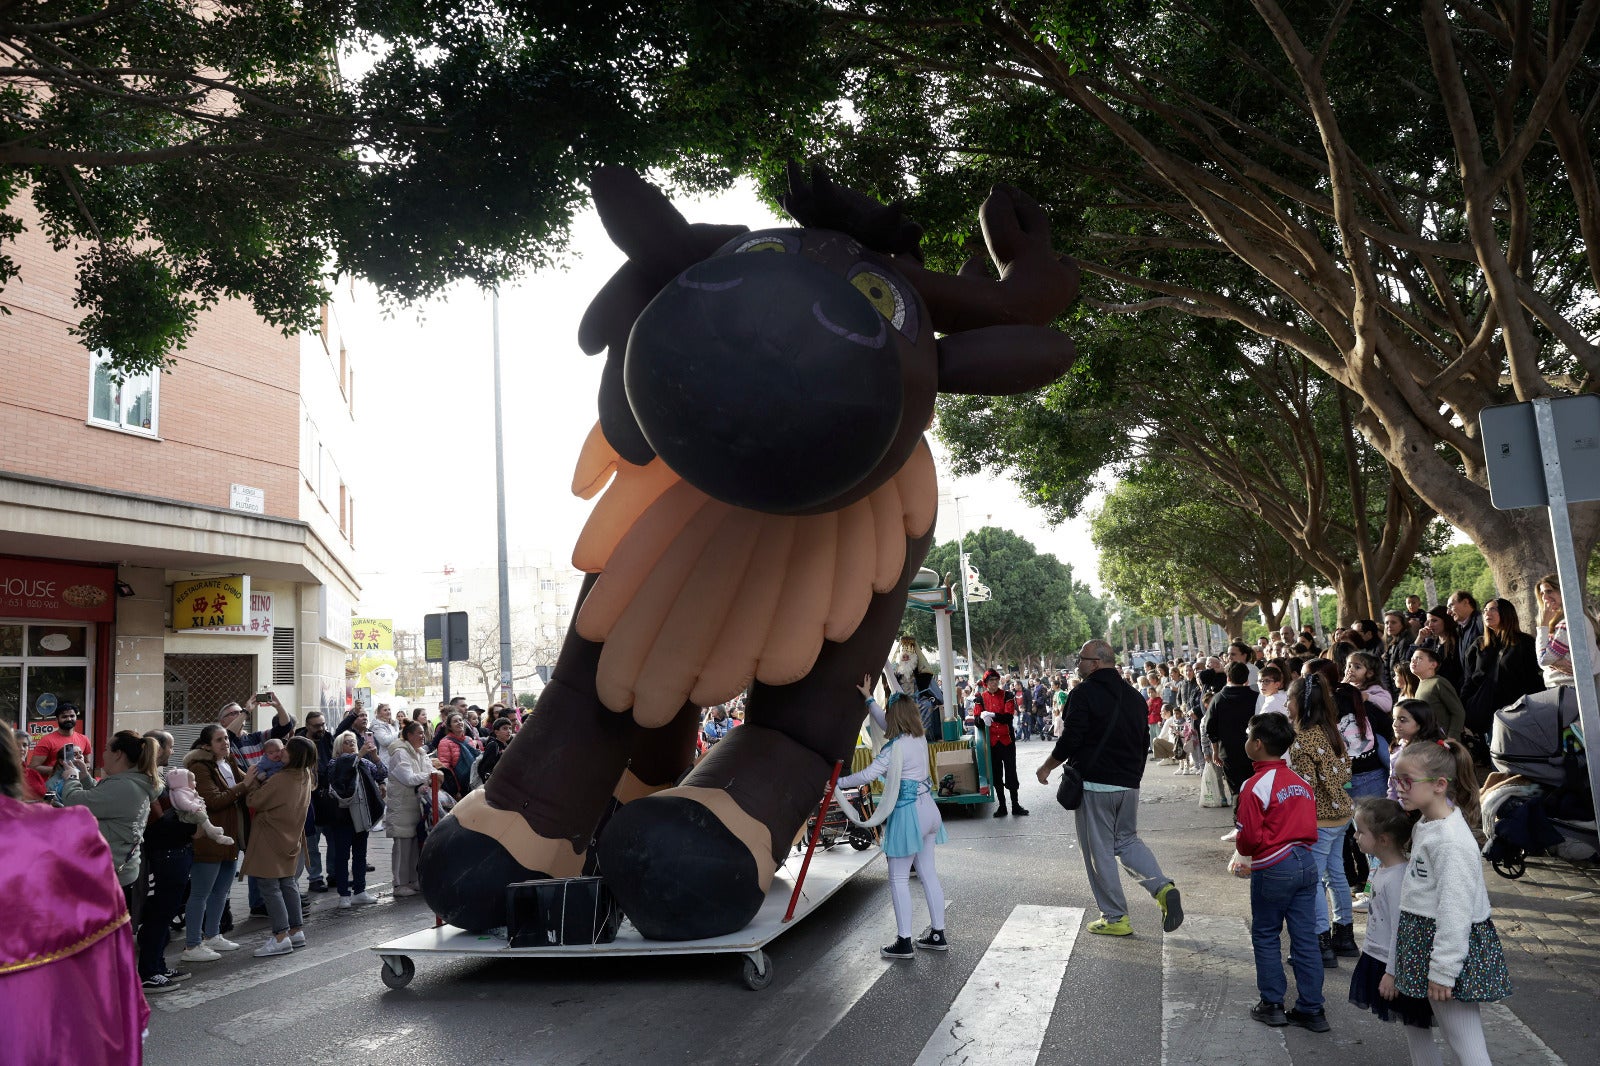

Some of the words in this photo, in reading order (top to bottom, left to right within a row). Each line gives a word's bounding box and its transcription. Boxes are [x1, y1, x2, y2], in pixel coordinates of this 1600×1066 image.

[0, 577, 56, 598] HOUSE
[176, 580, 222, 604] RESTAURANTE
[223, 583, 242, 599] CHINO
[192, 593, 228, 614] 西安
[249, 594, 271, 611] HINO
[192, 616, 204, 627] XI
[208, 615, 225, 625] AN
[250, 617, 271, 633] 西安
[353, 628, 380, 642] 西安
[353, 642, 363, 650] XI
[366, 642, 379, 650] AN
[30, 723, 54, 734] Taco
